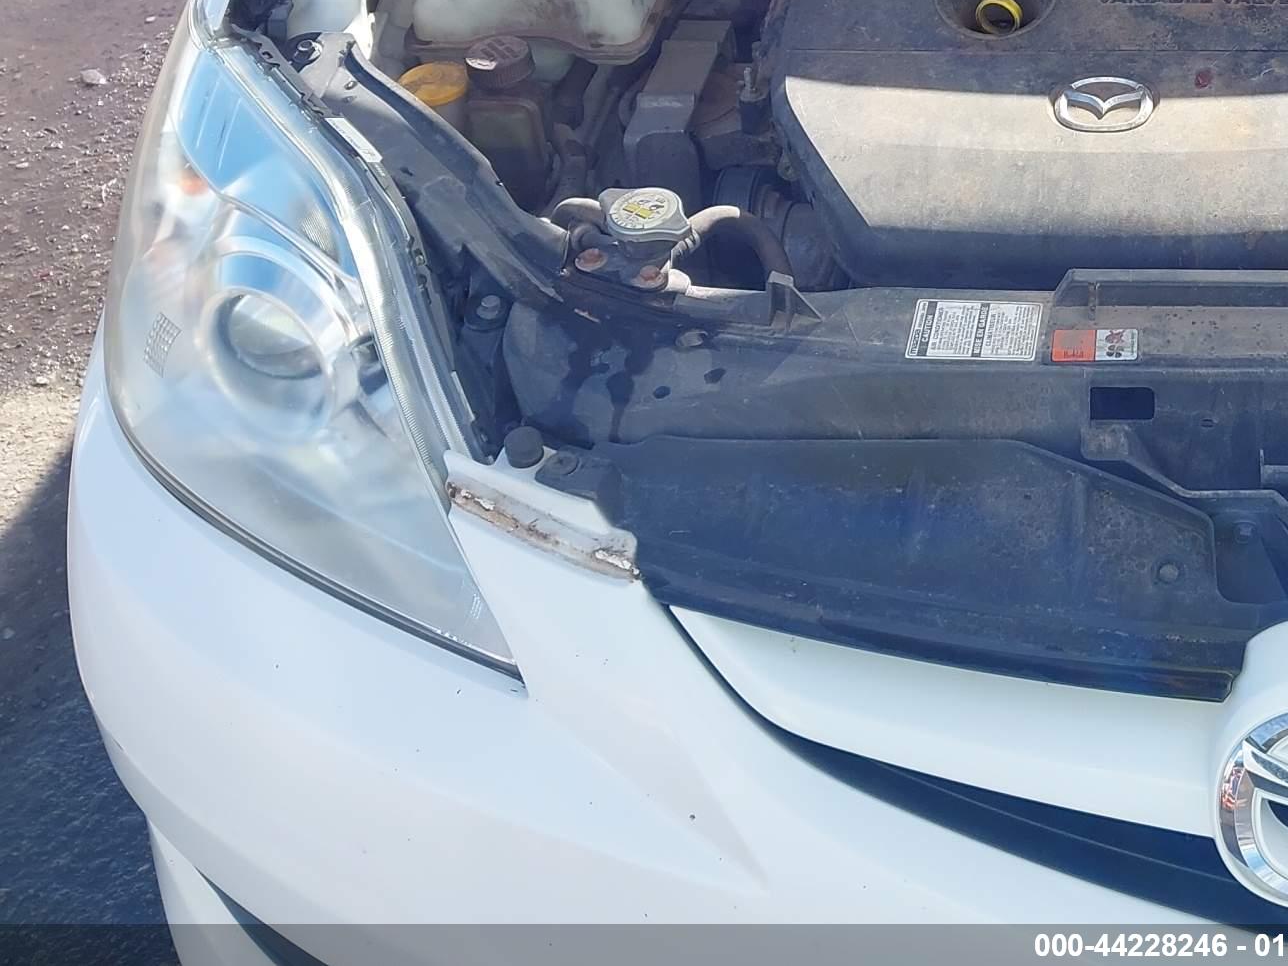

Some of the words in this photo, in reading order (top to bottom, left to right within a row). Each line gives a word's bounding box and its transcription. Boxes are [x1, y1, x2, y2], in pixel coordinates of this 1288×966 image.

[977, 305, 989, 327] GARDE
[921, 313, 934, 343] CAUTION
[975, 327, 985, 338] EN
[973, 338, 983, 354] MISE
